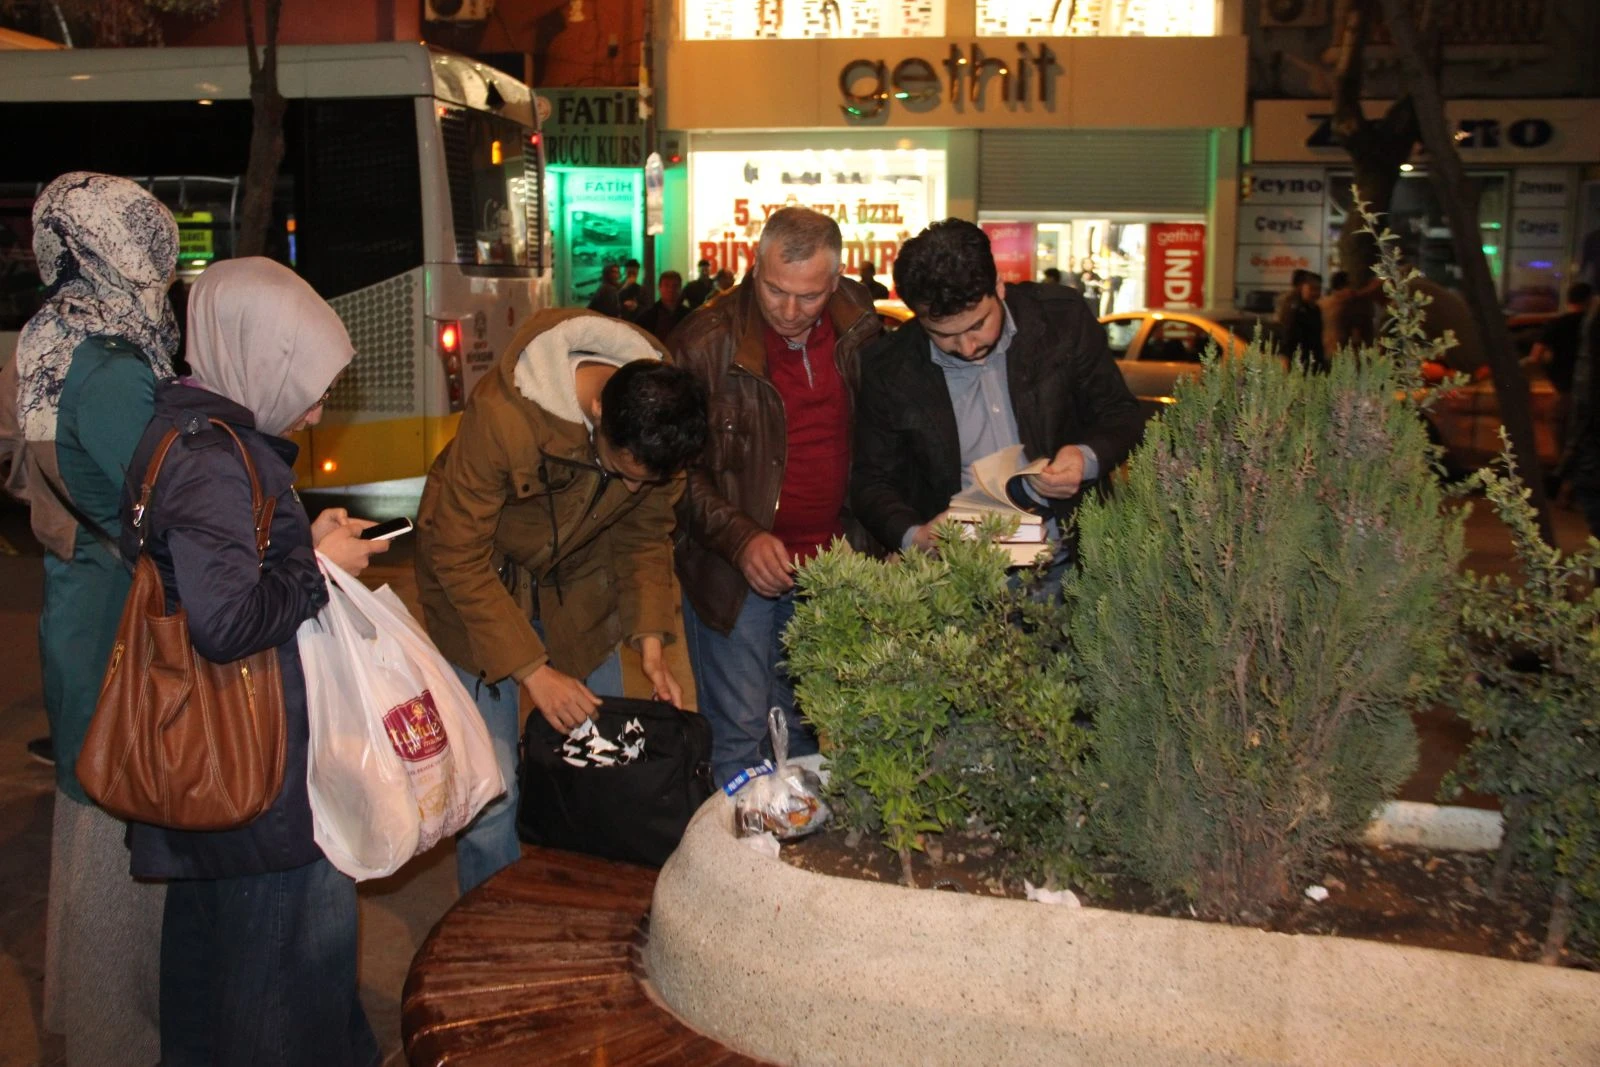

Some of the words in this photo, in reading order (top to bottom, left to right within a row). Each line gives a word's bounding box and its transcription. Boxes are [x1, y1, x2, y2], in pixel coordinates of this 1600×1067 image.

[838, 42, 1058, 118] gethit
[857, 198, 903, 225] ÖZEL
[698, 231, 756, 275] BÜY
[1157, 228, 1201, 246] gethit
